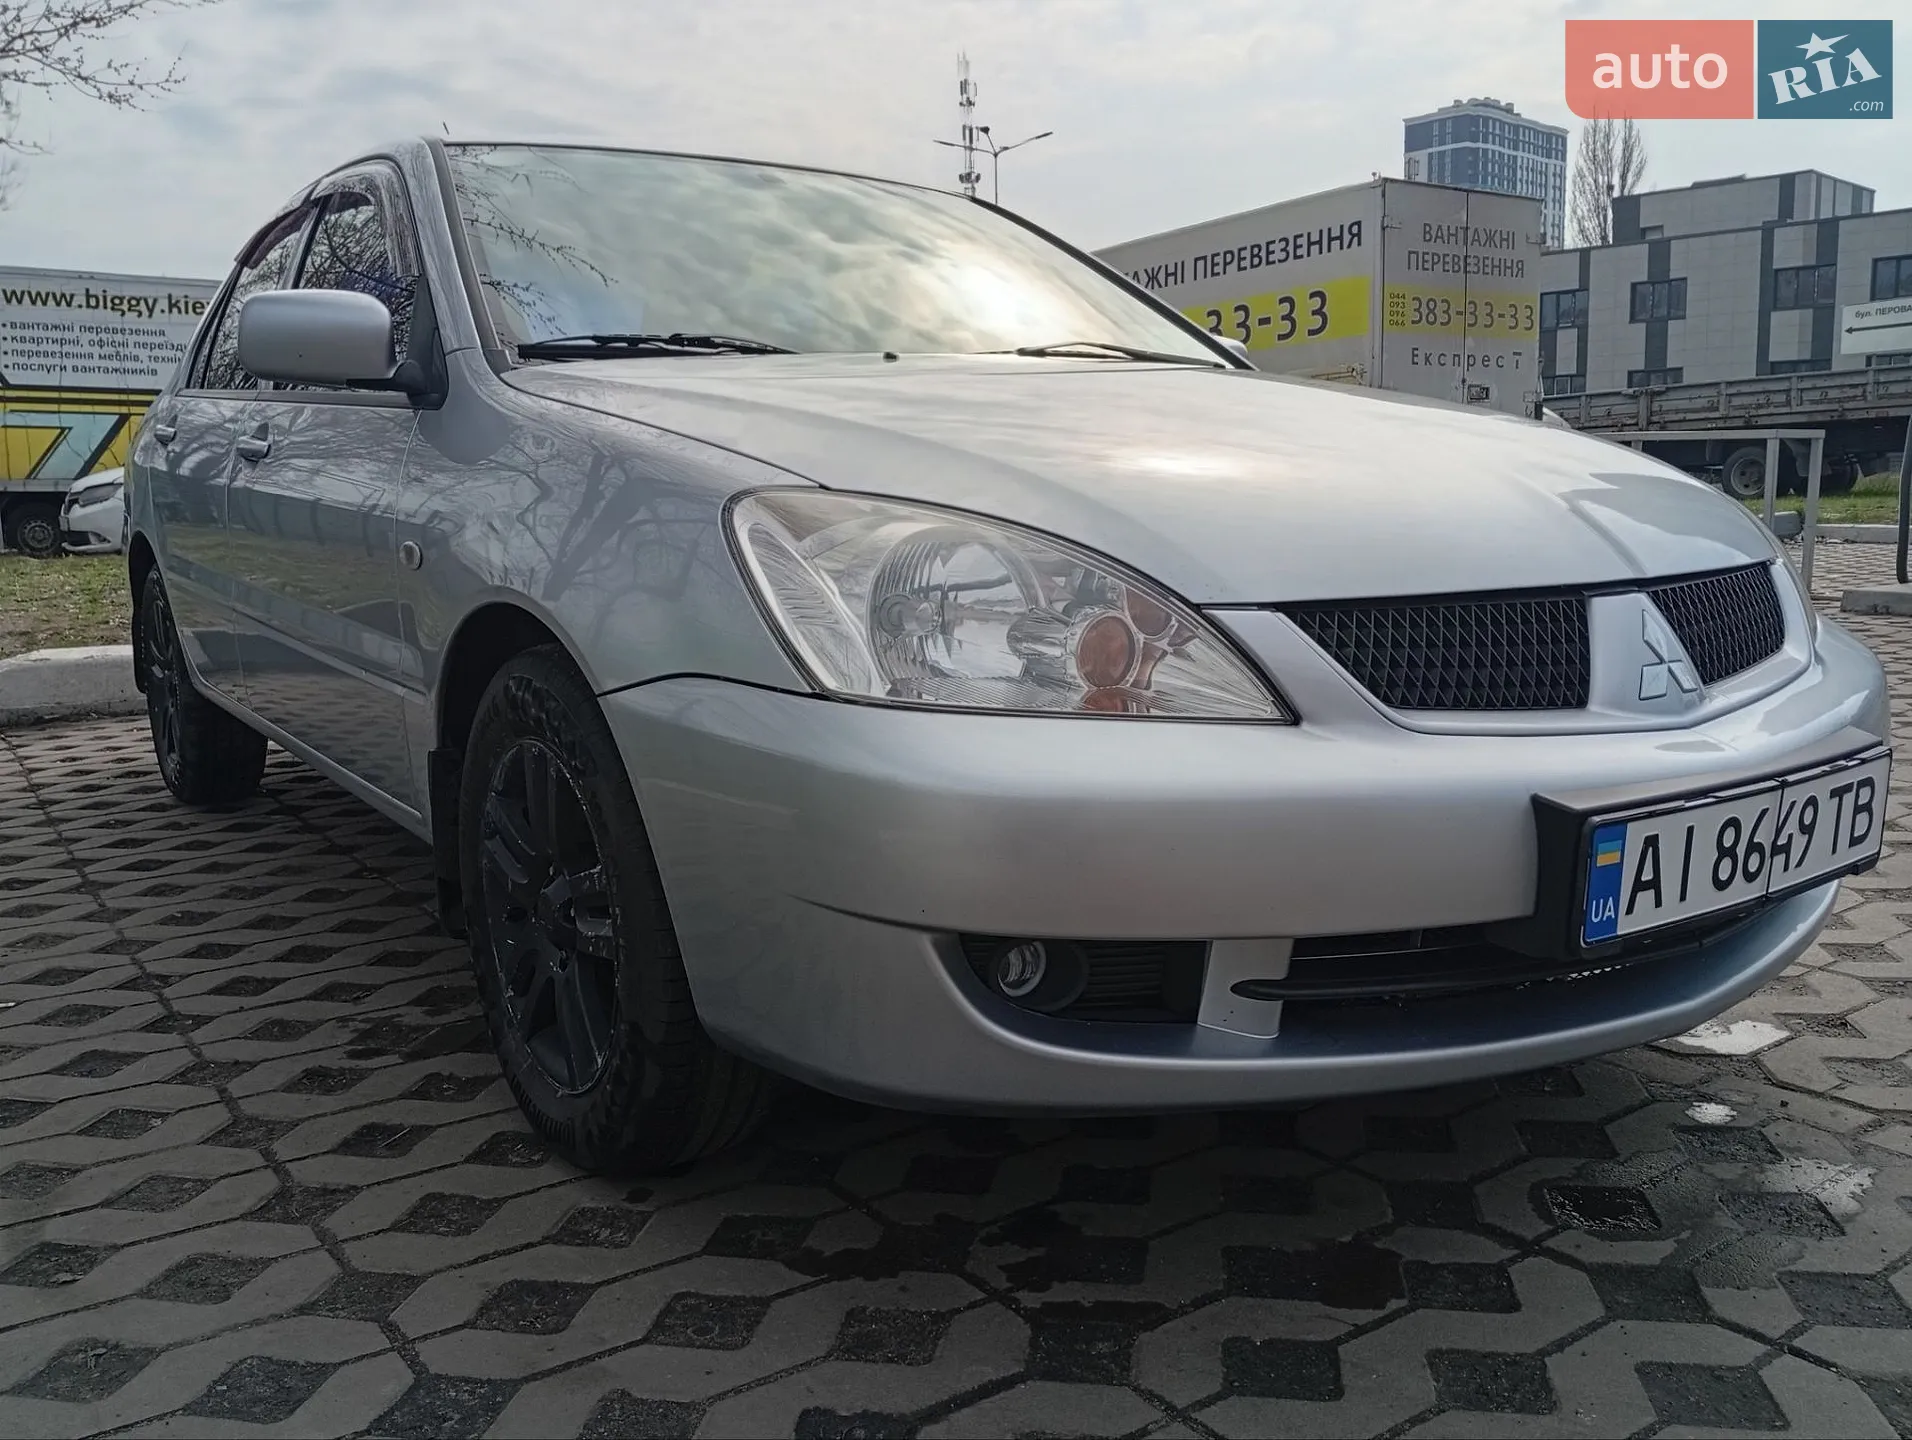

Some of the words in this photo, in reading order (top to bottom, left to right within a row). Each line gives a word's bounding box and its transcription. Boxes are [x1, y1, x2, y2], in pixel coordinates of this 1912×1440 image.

[1193, 220, 1363, 281] ПЕРЕВЕЗЕННЯ
[1423, 222, 1516, 250] ВАНТАЖНІ
[1407, 249, 1525, 279] ПЕРЕВЕЗЕННЯ
[1, 288, 210, 318] www.biggy.kie
[1410, 296, 1535, 332] 383-33-33
[9, 321, 75, 333] вантажні
[79, 326, 166, 337] перевезення
[1411, 347, 1505, 372] Експрес
[1625, 824, 1695, 915] AI
[1711, 794, 1819, 892] 8649
[1829, 776, 1875, 856] TB
[1591, 899, 1616, 923] UA
